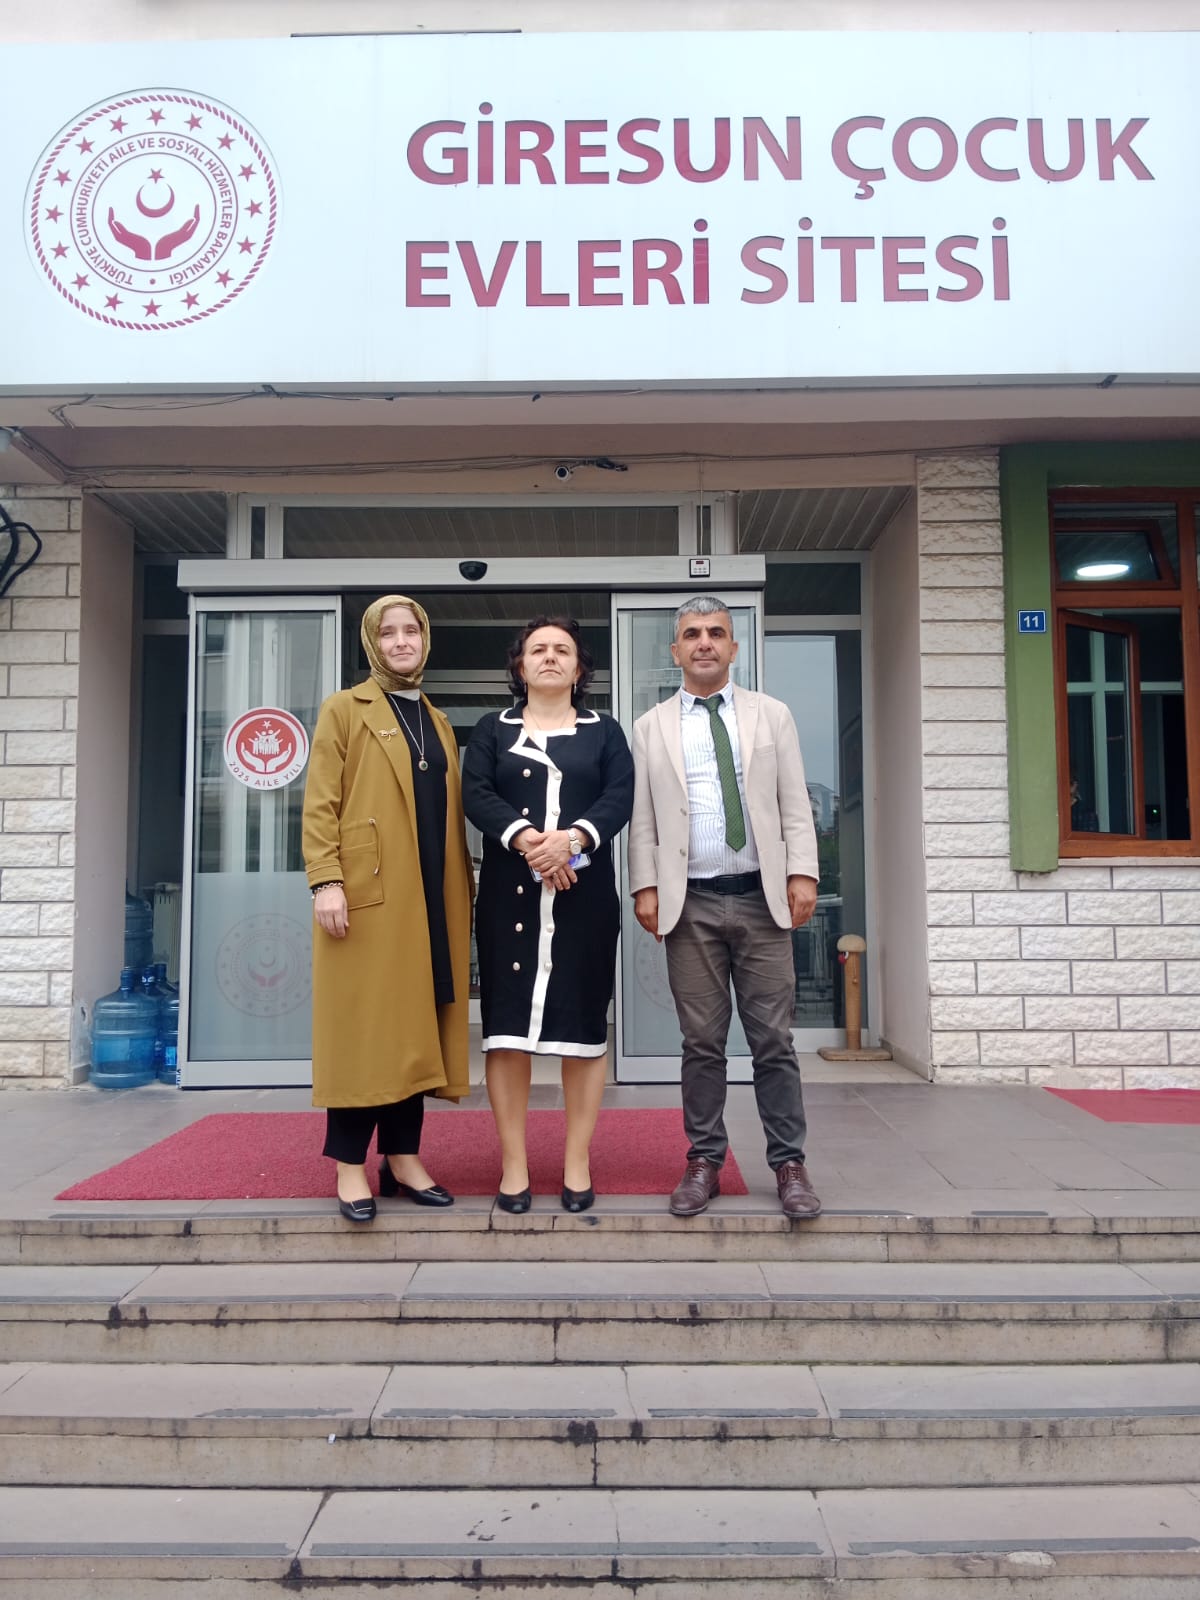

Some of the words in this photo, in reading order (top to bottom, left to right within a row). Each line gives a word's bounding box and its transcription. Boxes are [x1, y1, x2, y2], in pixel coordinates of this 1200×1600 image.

[108, 142, 136, 163] AİLE
[137, 137, 155, 149] VE
[158, 137, 205, 162] SOSYAL
[406, 102, 802, 185] GİRESUN
[831, 115, 1156, 200] ÇOCUK
[76, 158, 109, 246] CUMHURİYETİ
[204, 158, 233, 229] HİZMETLER
[86, 246, 133, 285] TÜRKİYE
[169, 231, 228, 285] BAKANLIĞI
[405, 218, 710, 307] EVLERİ
[740, 217, 1011, 304] SİTESİ
[1023, 615, 1039, 628] 11
[229, 761, 250, 782] 2025
[283, 763, 302, 780] YILI
